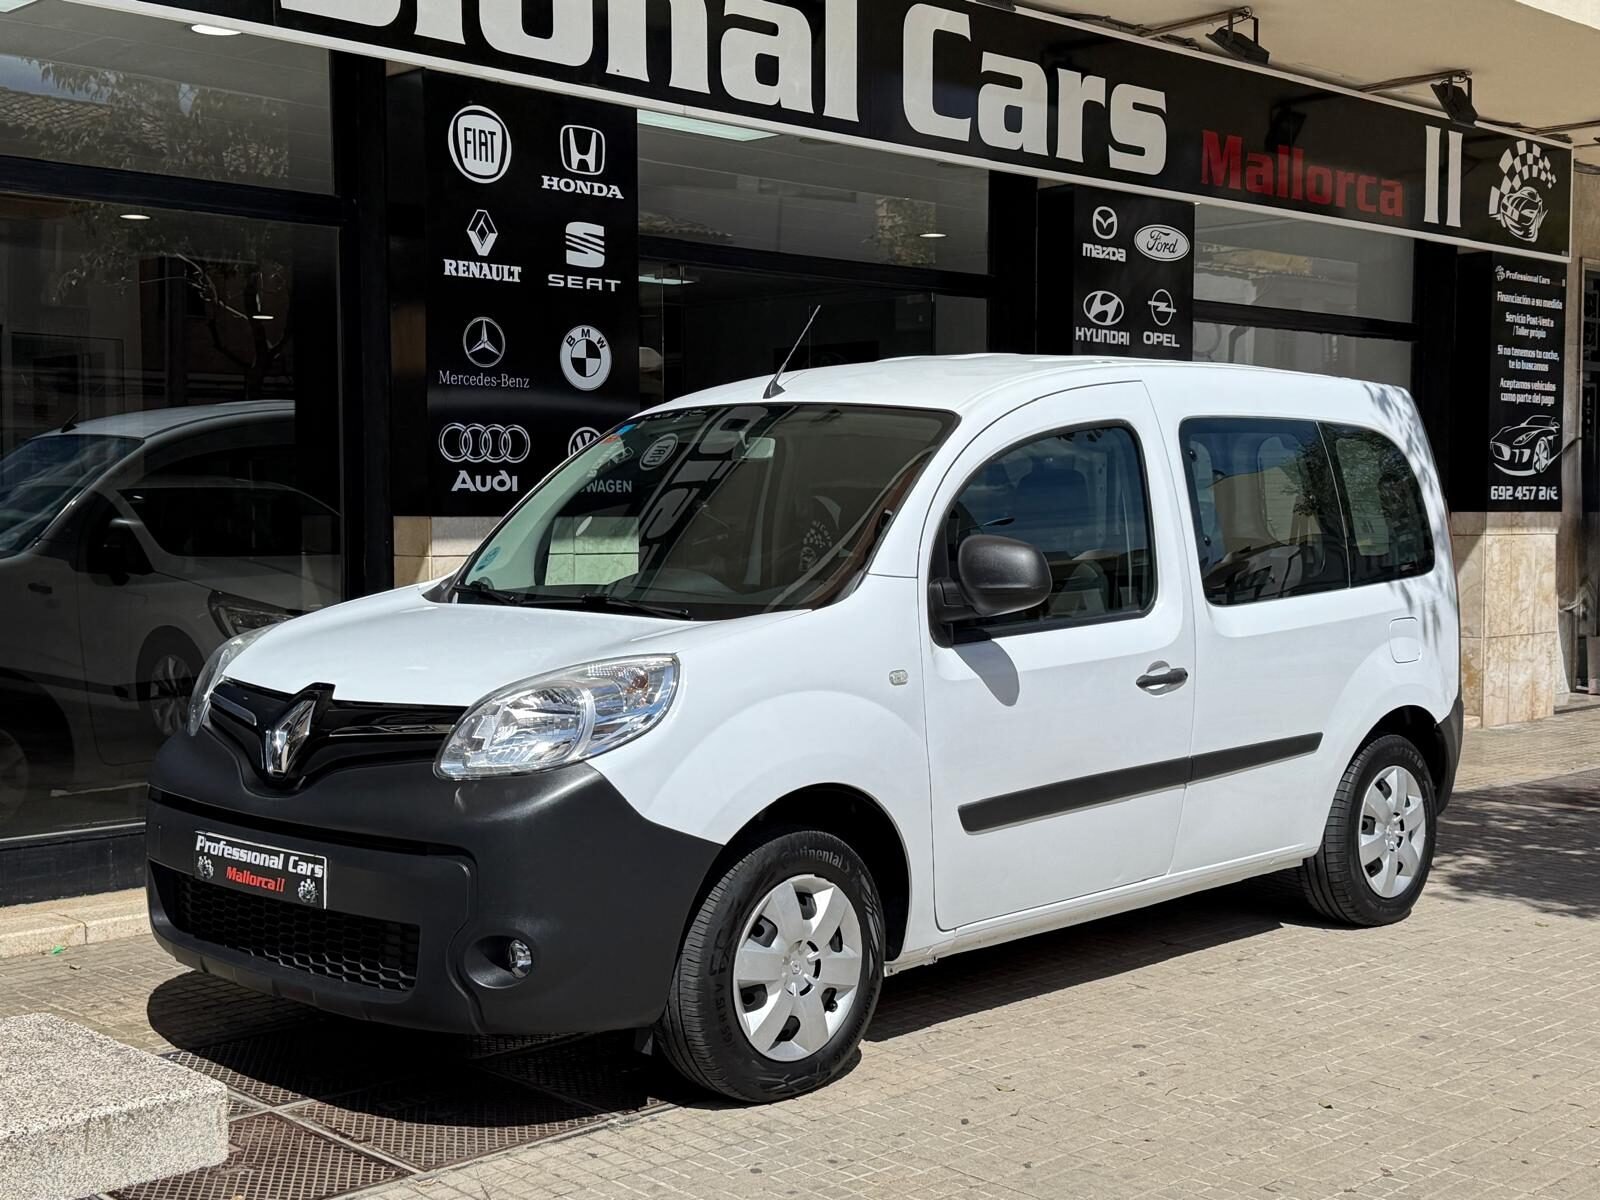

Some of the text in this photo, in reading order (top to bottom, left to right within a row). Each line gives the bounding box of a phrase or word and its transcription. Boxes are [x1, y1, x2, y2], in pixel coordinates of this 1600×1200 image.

[903, 3, 1167, 175] Cars
[1201, 129, 1403, 217] Mallorca
[464, 126, 496, 163] FIAT
[541, 175, 624, 199] HONDA
[1146, 229, 1178, 254] Ford
[443, 258, 522, 282] RENAULT
[1505, 270, 1539, 283] Professional
[1539, 275, 1551, 285] Cars
[548, 273, 621, 292] SEAT
[1543, 299, 1563, 310] medida
[1505, 311, 1526, 324] Servicio
[1075, 326, 1130, 345] HYUNDAI
[1143, 331, 1180, 347] OPEL
[1503, 347, 1511, 355] no
[1511, 346, 1535, 358] tenemos
[1508, 359, 1515, 369] te
[1521, 359, 1549, 372] buscamos
[438, 370, 530, 388] Mercedes-Benz
[1499, 377, 1531, 391] Aceptamos
[1500, 392, 1555, 407] como parte del pago
[451, 470, 518, 492] Audi
[1490, 485, 1514, 500] 692
[1514, 485, 1537, 500] 457
[195, 835, 324, 879] Professional Cars
[225, 866, 276, 891] Mallorca
